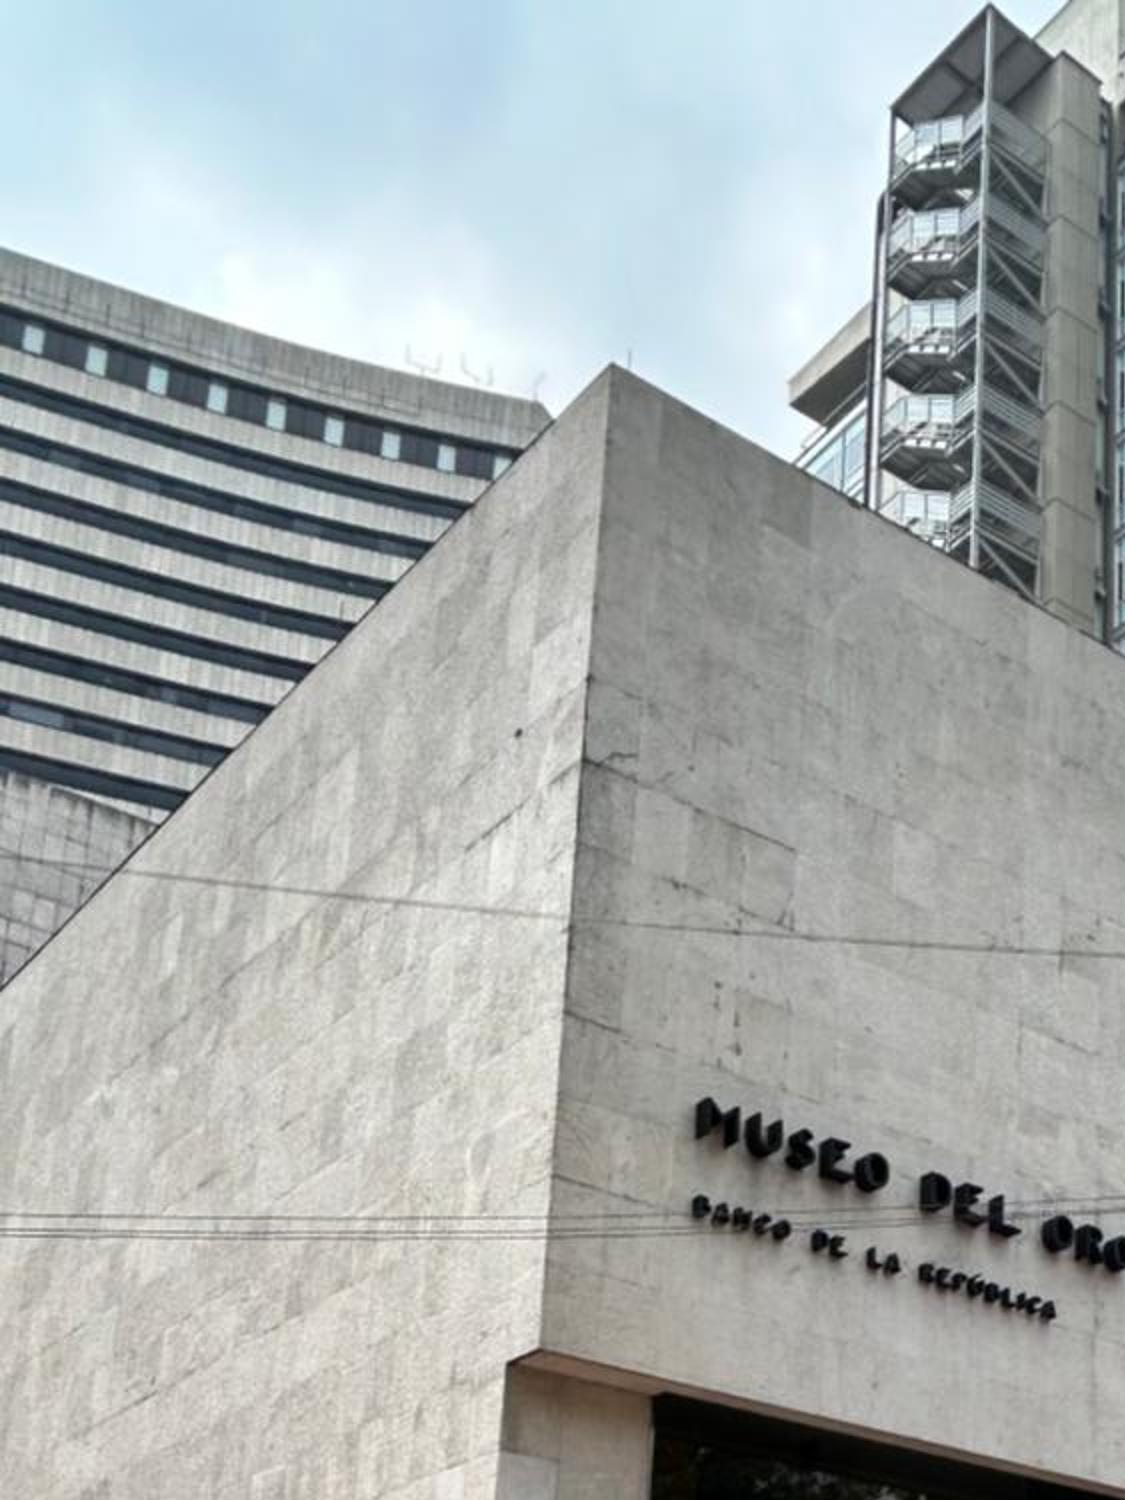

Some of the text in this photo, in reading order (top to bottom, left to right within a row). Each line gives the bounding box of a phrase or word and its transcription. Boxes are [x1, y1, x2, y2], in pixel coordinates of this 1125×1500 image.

[694, 1096, 890, 1193] MUSEO
[919, 1171, 1022, 1238] DEL
[691, 1194, 1057, 1321] BANCO DE LA REPÚBLICA
